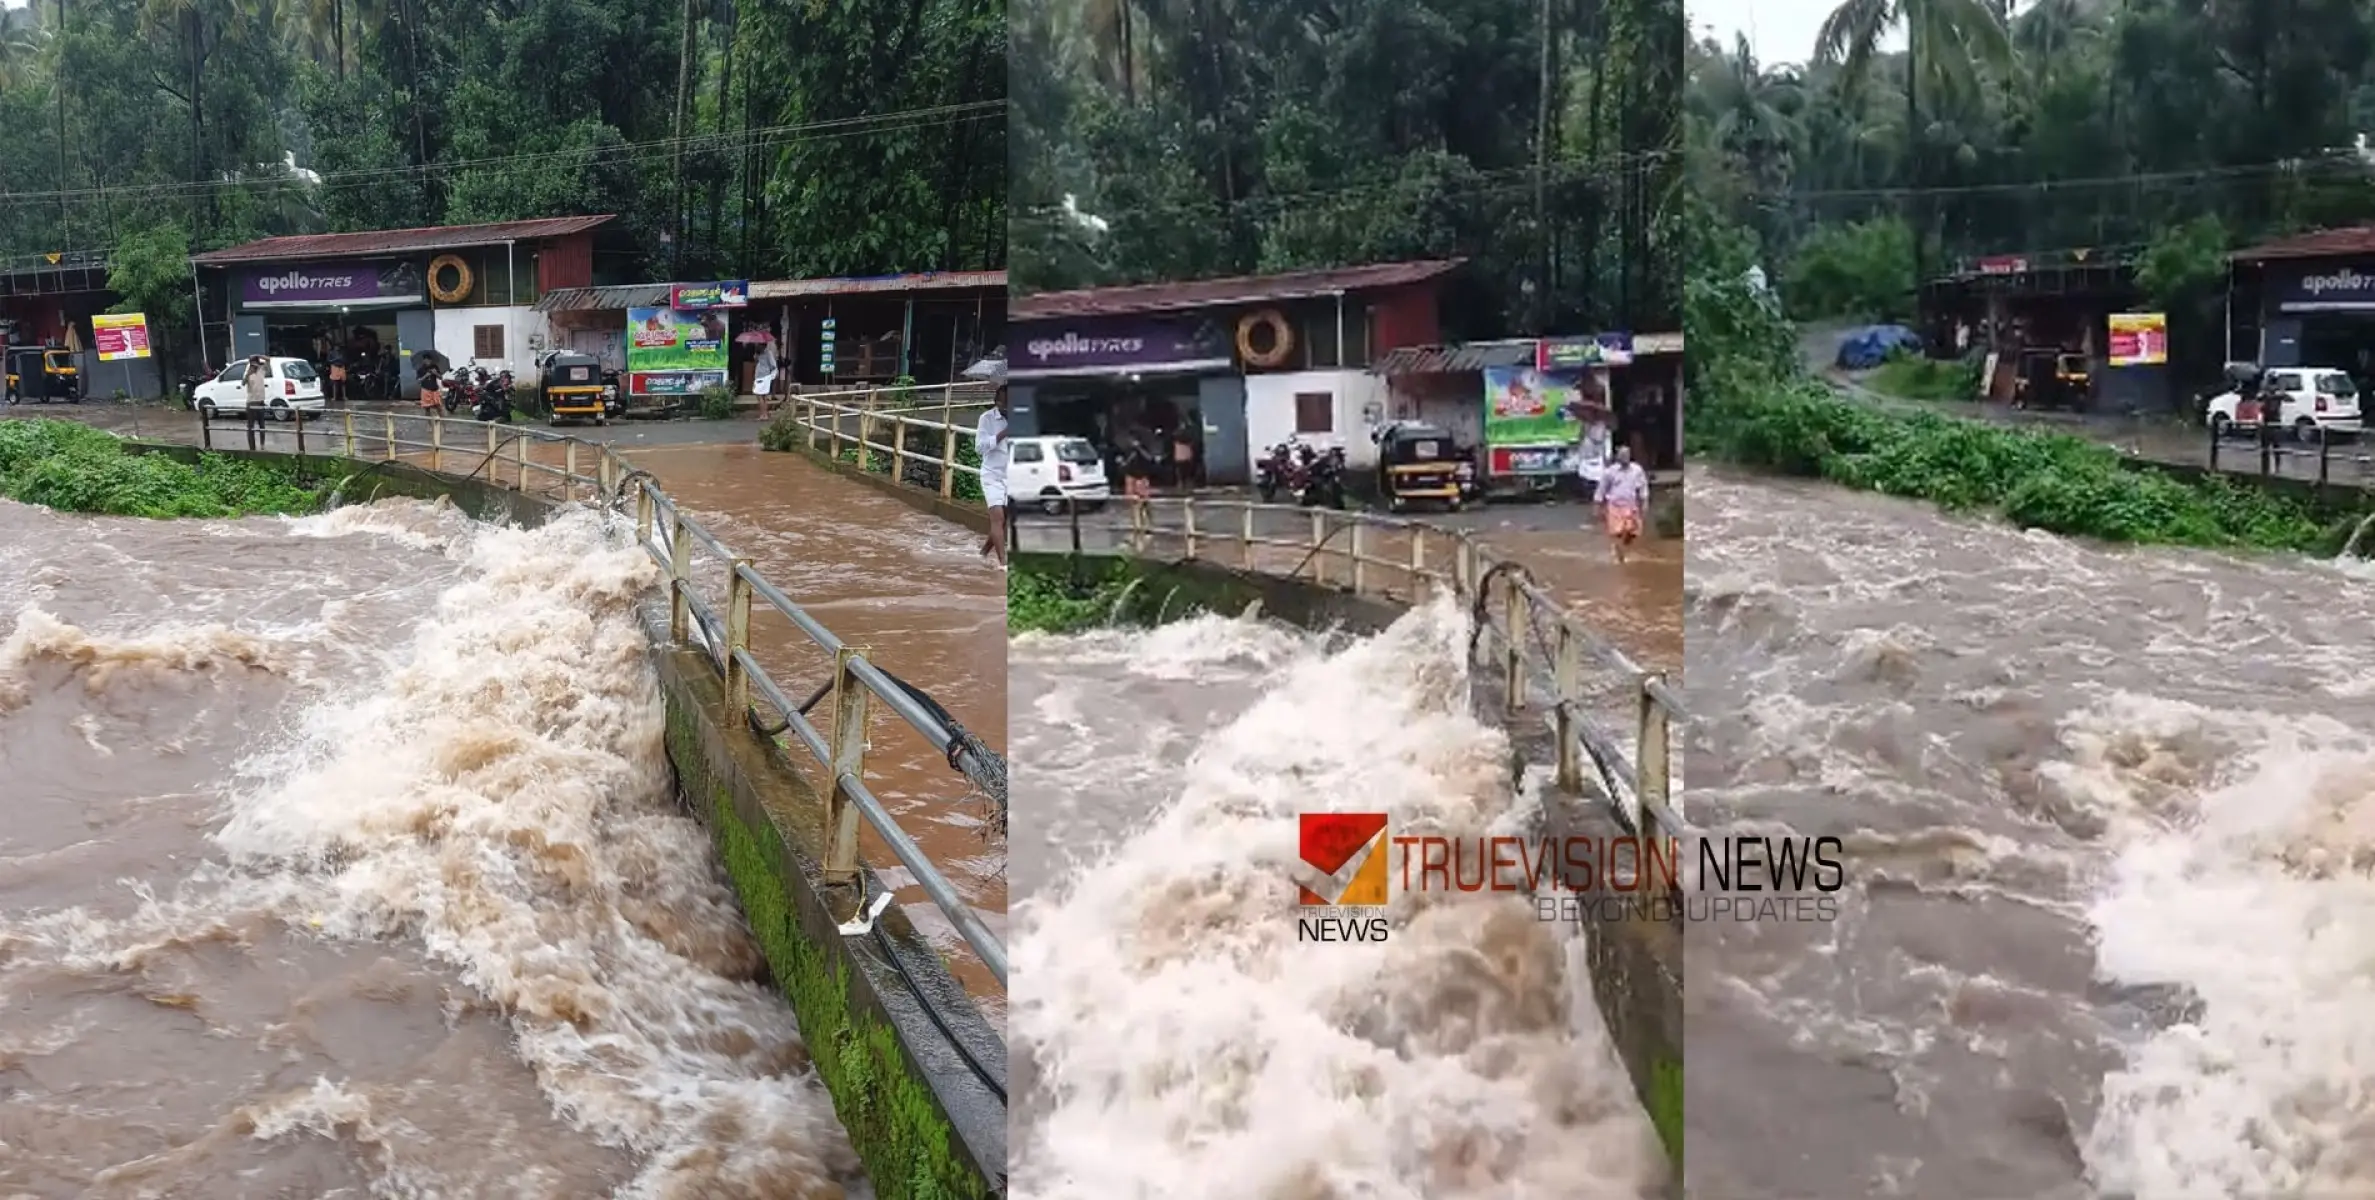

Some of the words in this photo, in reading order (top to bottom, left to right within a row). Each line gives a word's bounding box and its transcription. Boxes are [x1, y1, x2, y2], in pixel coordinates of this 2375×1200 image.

[259, 271, 309, 295] apollo
[309, 275, 353, 289] TYRES
[2302, 267, 2362, 296] apollo
